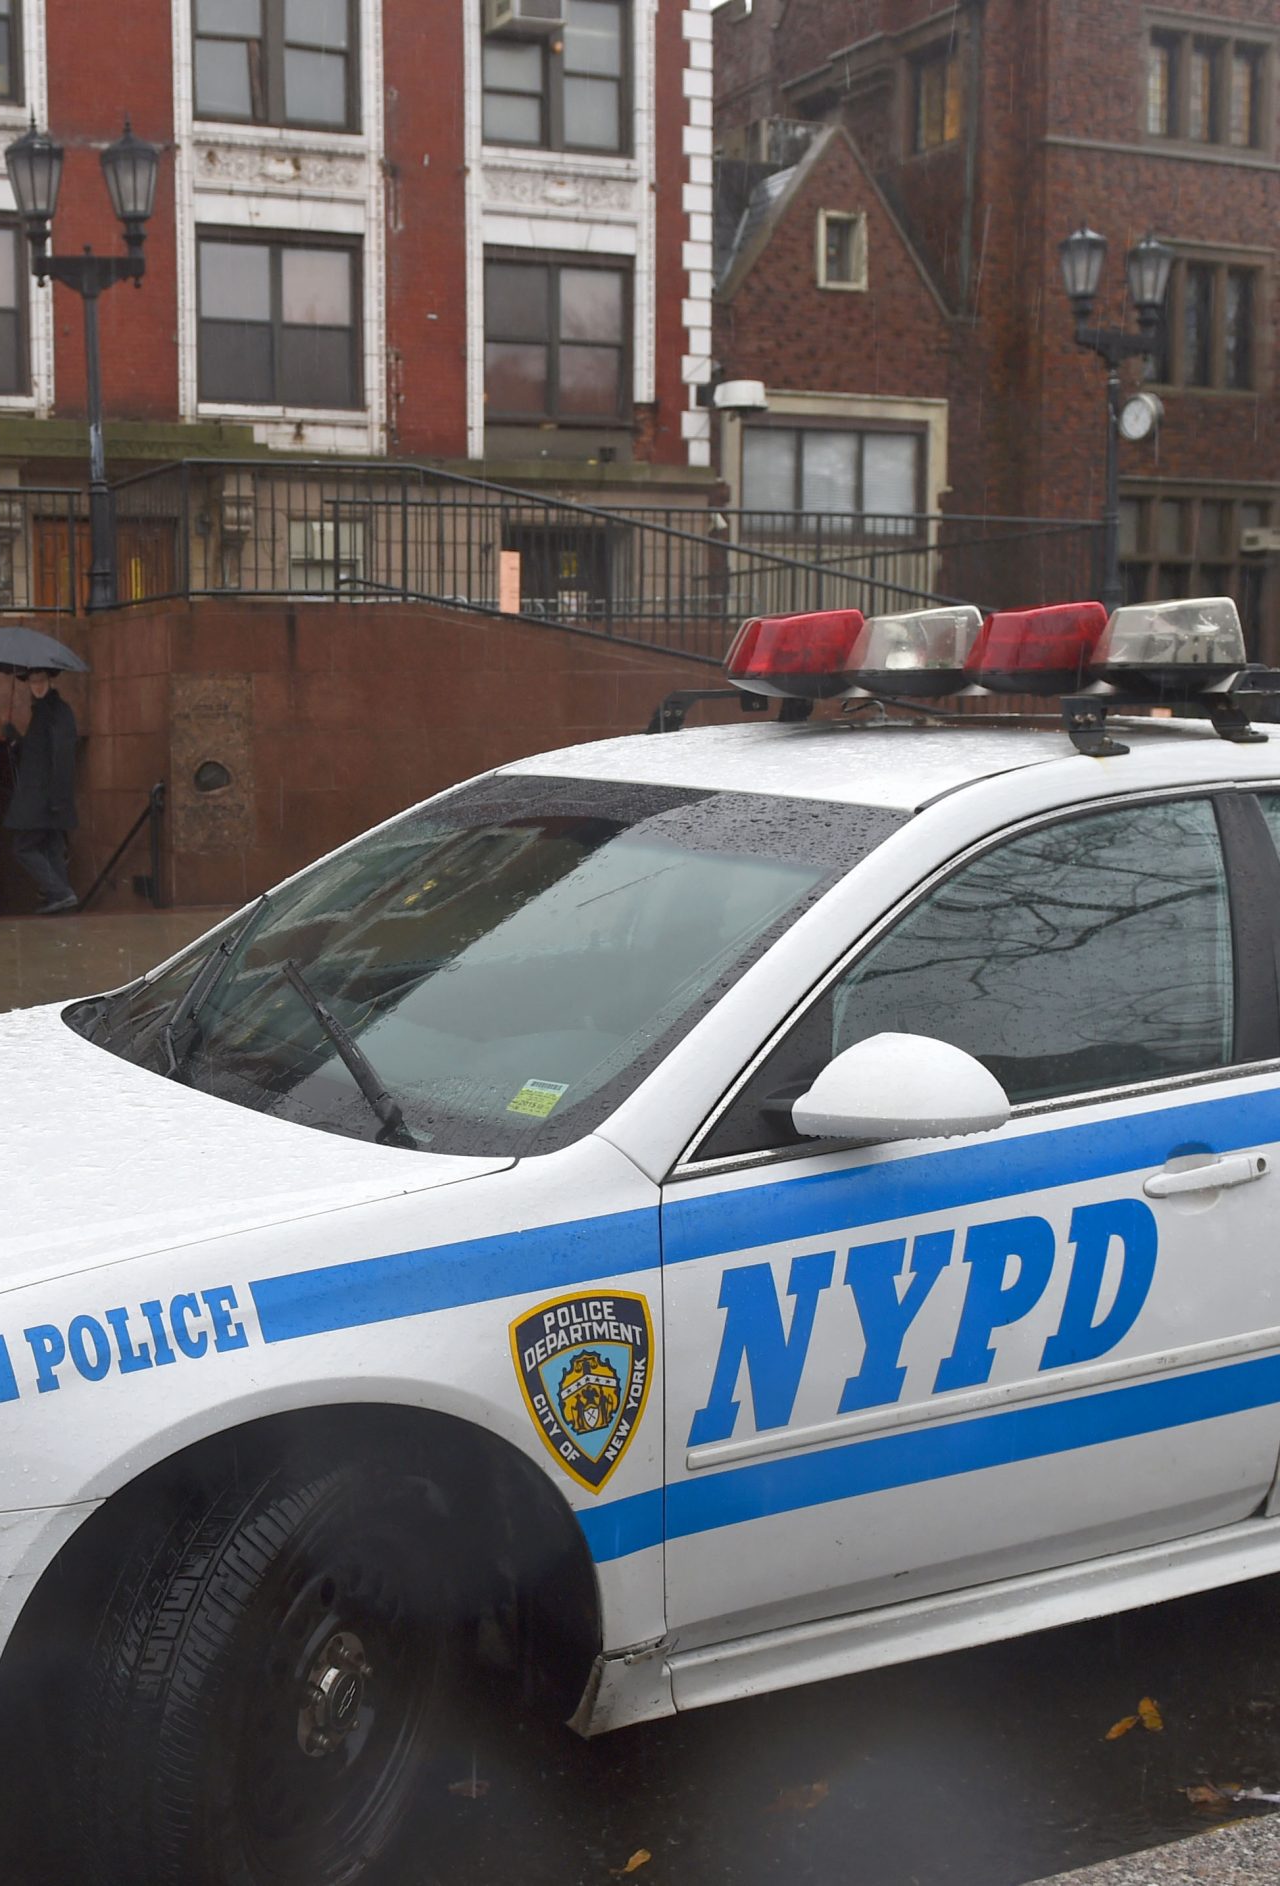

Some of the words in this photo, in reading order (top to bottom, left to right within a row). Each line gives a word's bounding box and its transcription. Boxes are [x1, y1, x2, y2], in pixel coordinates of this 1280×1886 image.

[24, 1285, 249, 1393] POLICE
[524, 1322, 643, 1373] DEPARTMENT
[543, 1301, 616, 1334] POLICE
[686, 1198, 1158, 1447] NYPD
[532, 1393, 561, 1439] CITY
[560, 1440, 581, 1462] OF
[604, 1418, 631, 1462] NEW
[626, 1357, 647, 1410] YORK
